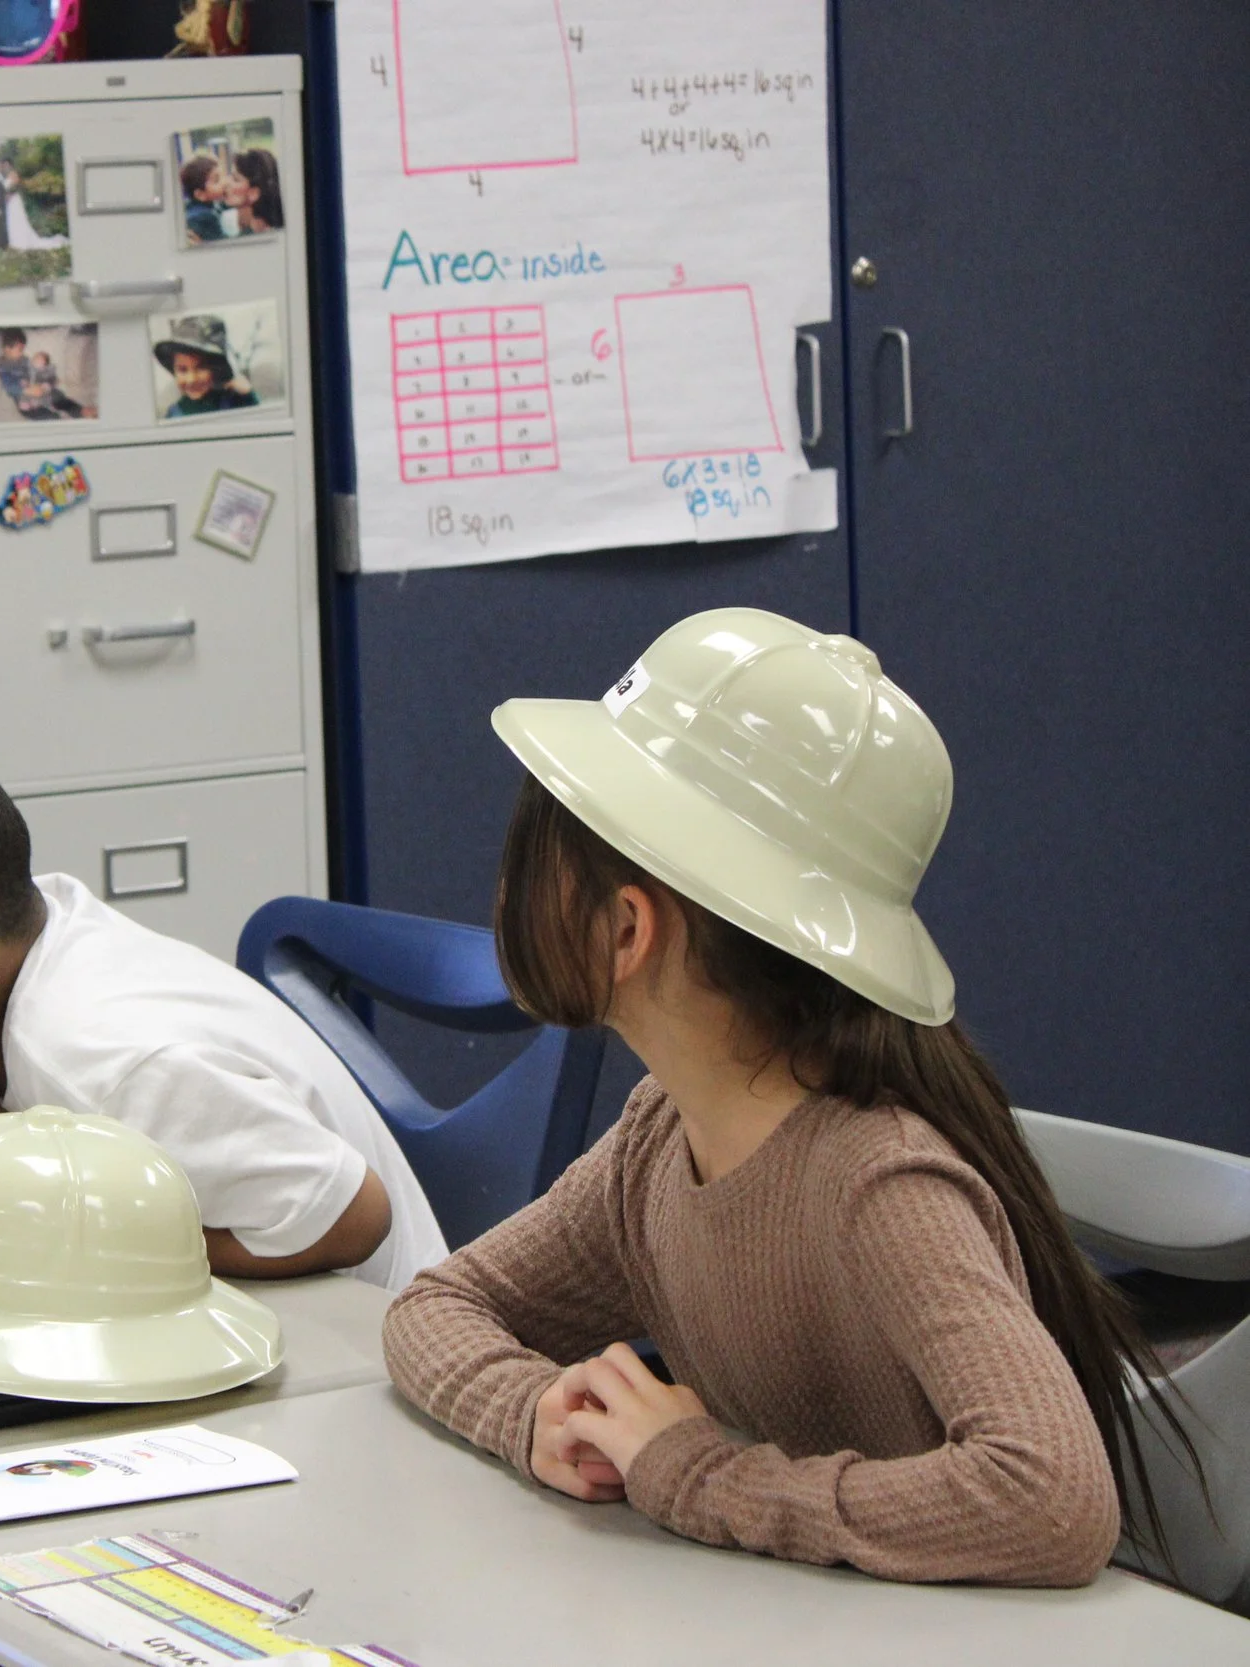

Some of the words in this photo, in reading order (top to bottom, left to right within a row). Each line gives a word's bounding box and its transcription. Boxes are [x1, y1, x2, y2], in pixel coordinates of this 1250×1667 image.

[569, 25, 584, 53] 4
[370, 53, 388, 87] 4
[468, 170, 484, 197] 4
[521, 240, 607, 281] inside
[669, 262, 686, 287] 3
[590, 327, 614, 361] 6
[427, 504, 455, 538] 18
